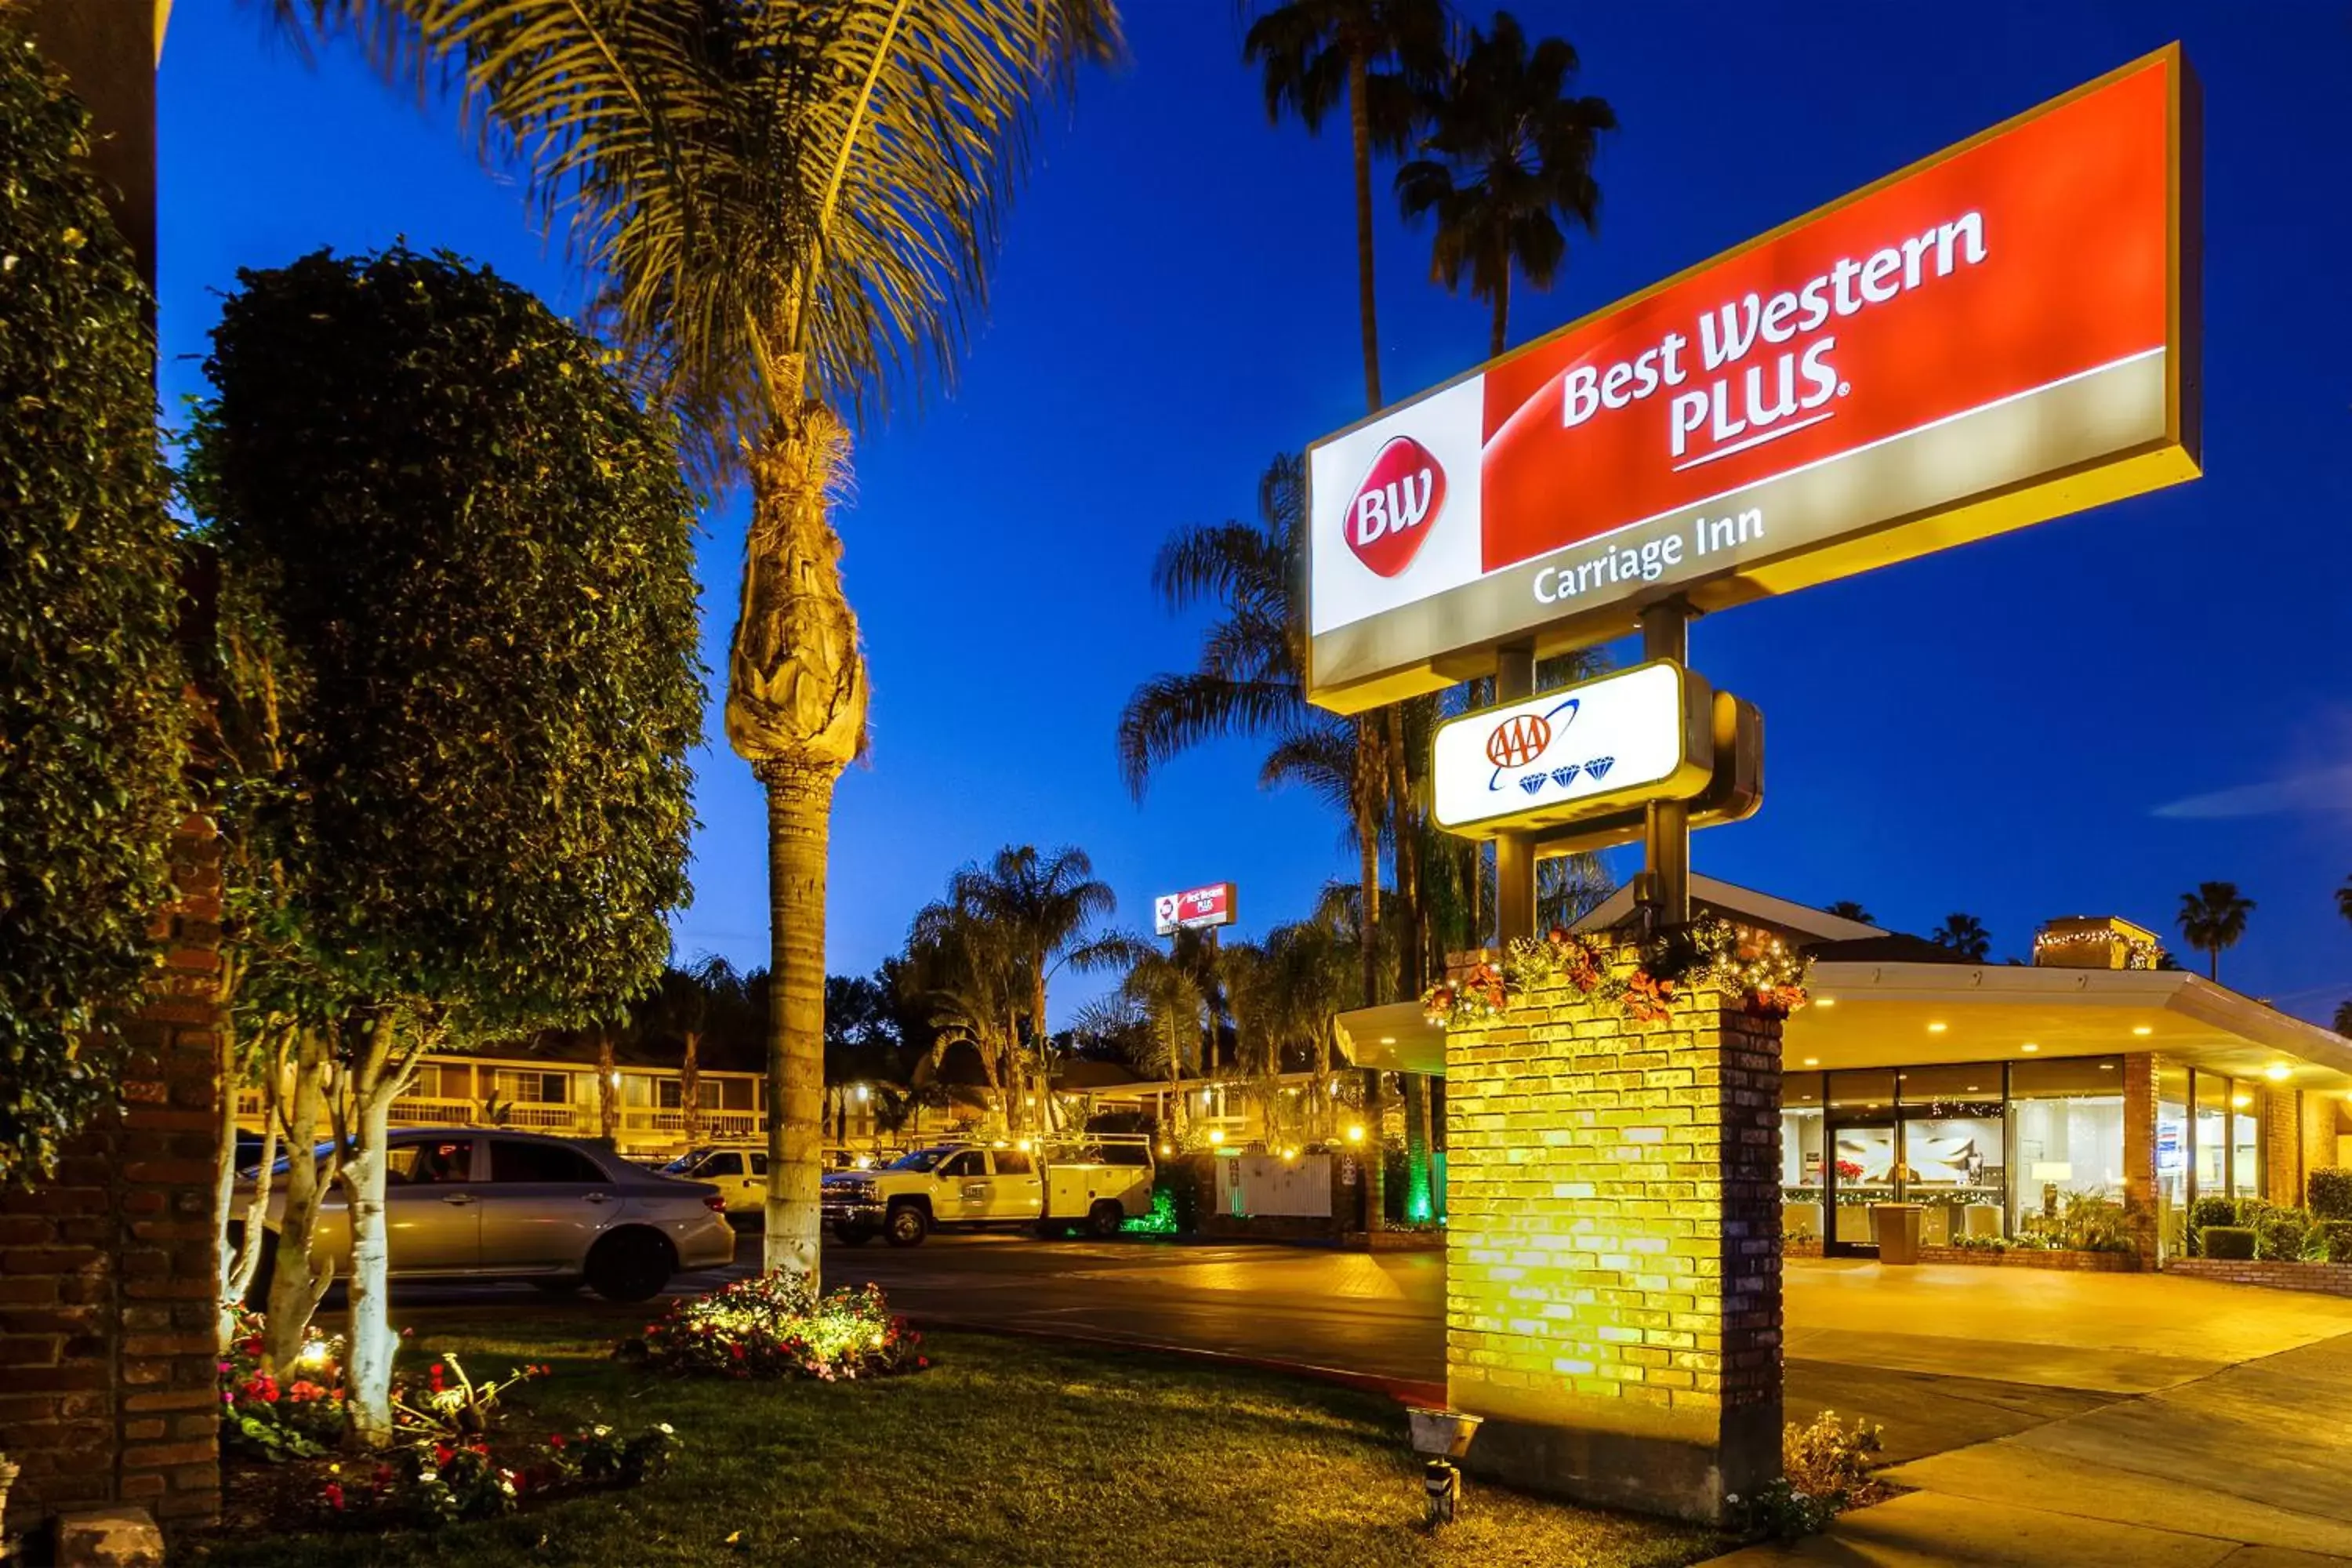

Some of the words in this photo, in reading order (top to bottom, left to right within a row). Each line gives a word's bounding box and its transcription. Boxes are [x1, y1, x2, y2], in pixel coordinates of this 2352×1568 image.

[1563, 333, 1686, 427] Best
[1699, 212, 1987, 371] Western
[1358, 468, 1433, 546] BW
[1534, 533, 1683, 604] Carriage
[1697, 507, 1765, 555] Inn
[1492, 716, 1545, 766] AAA
